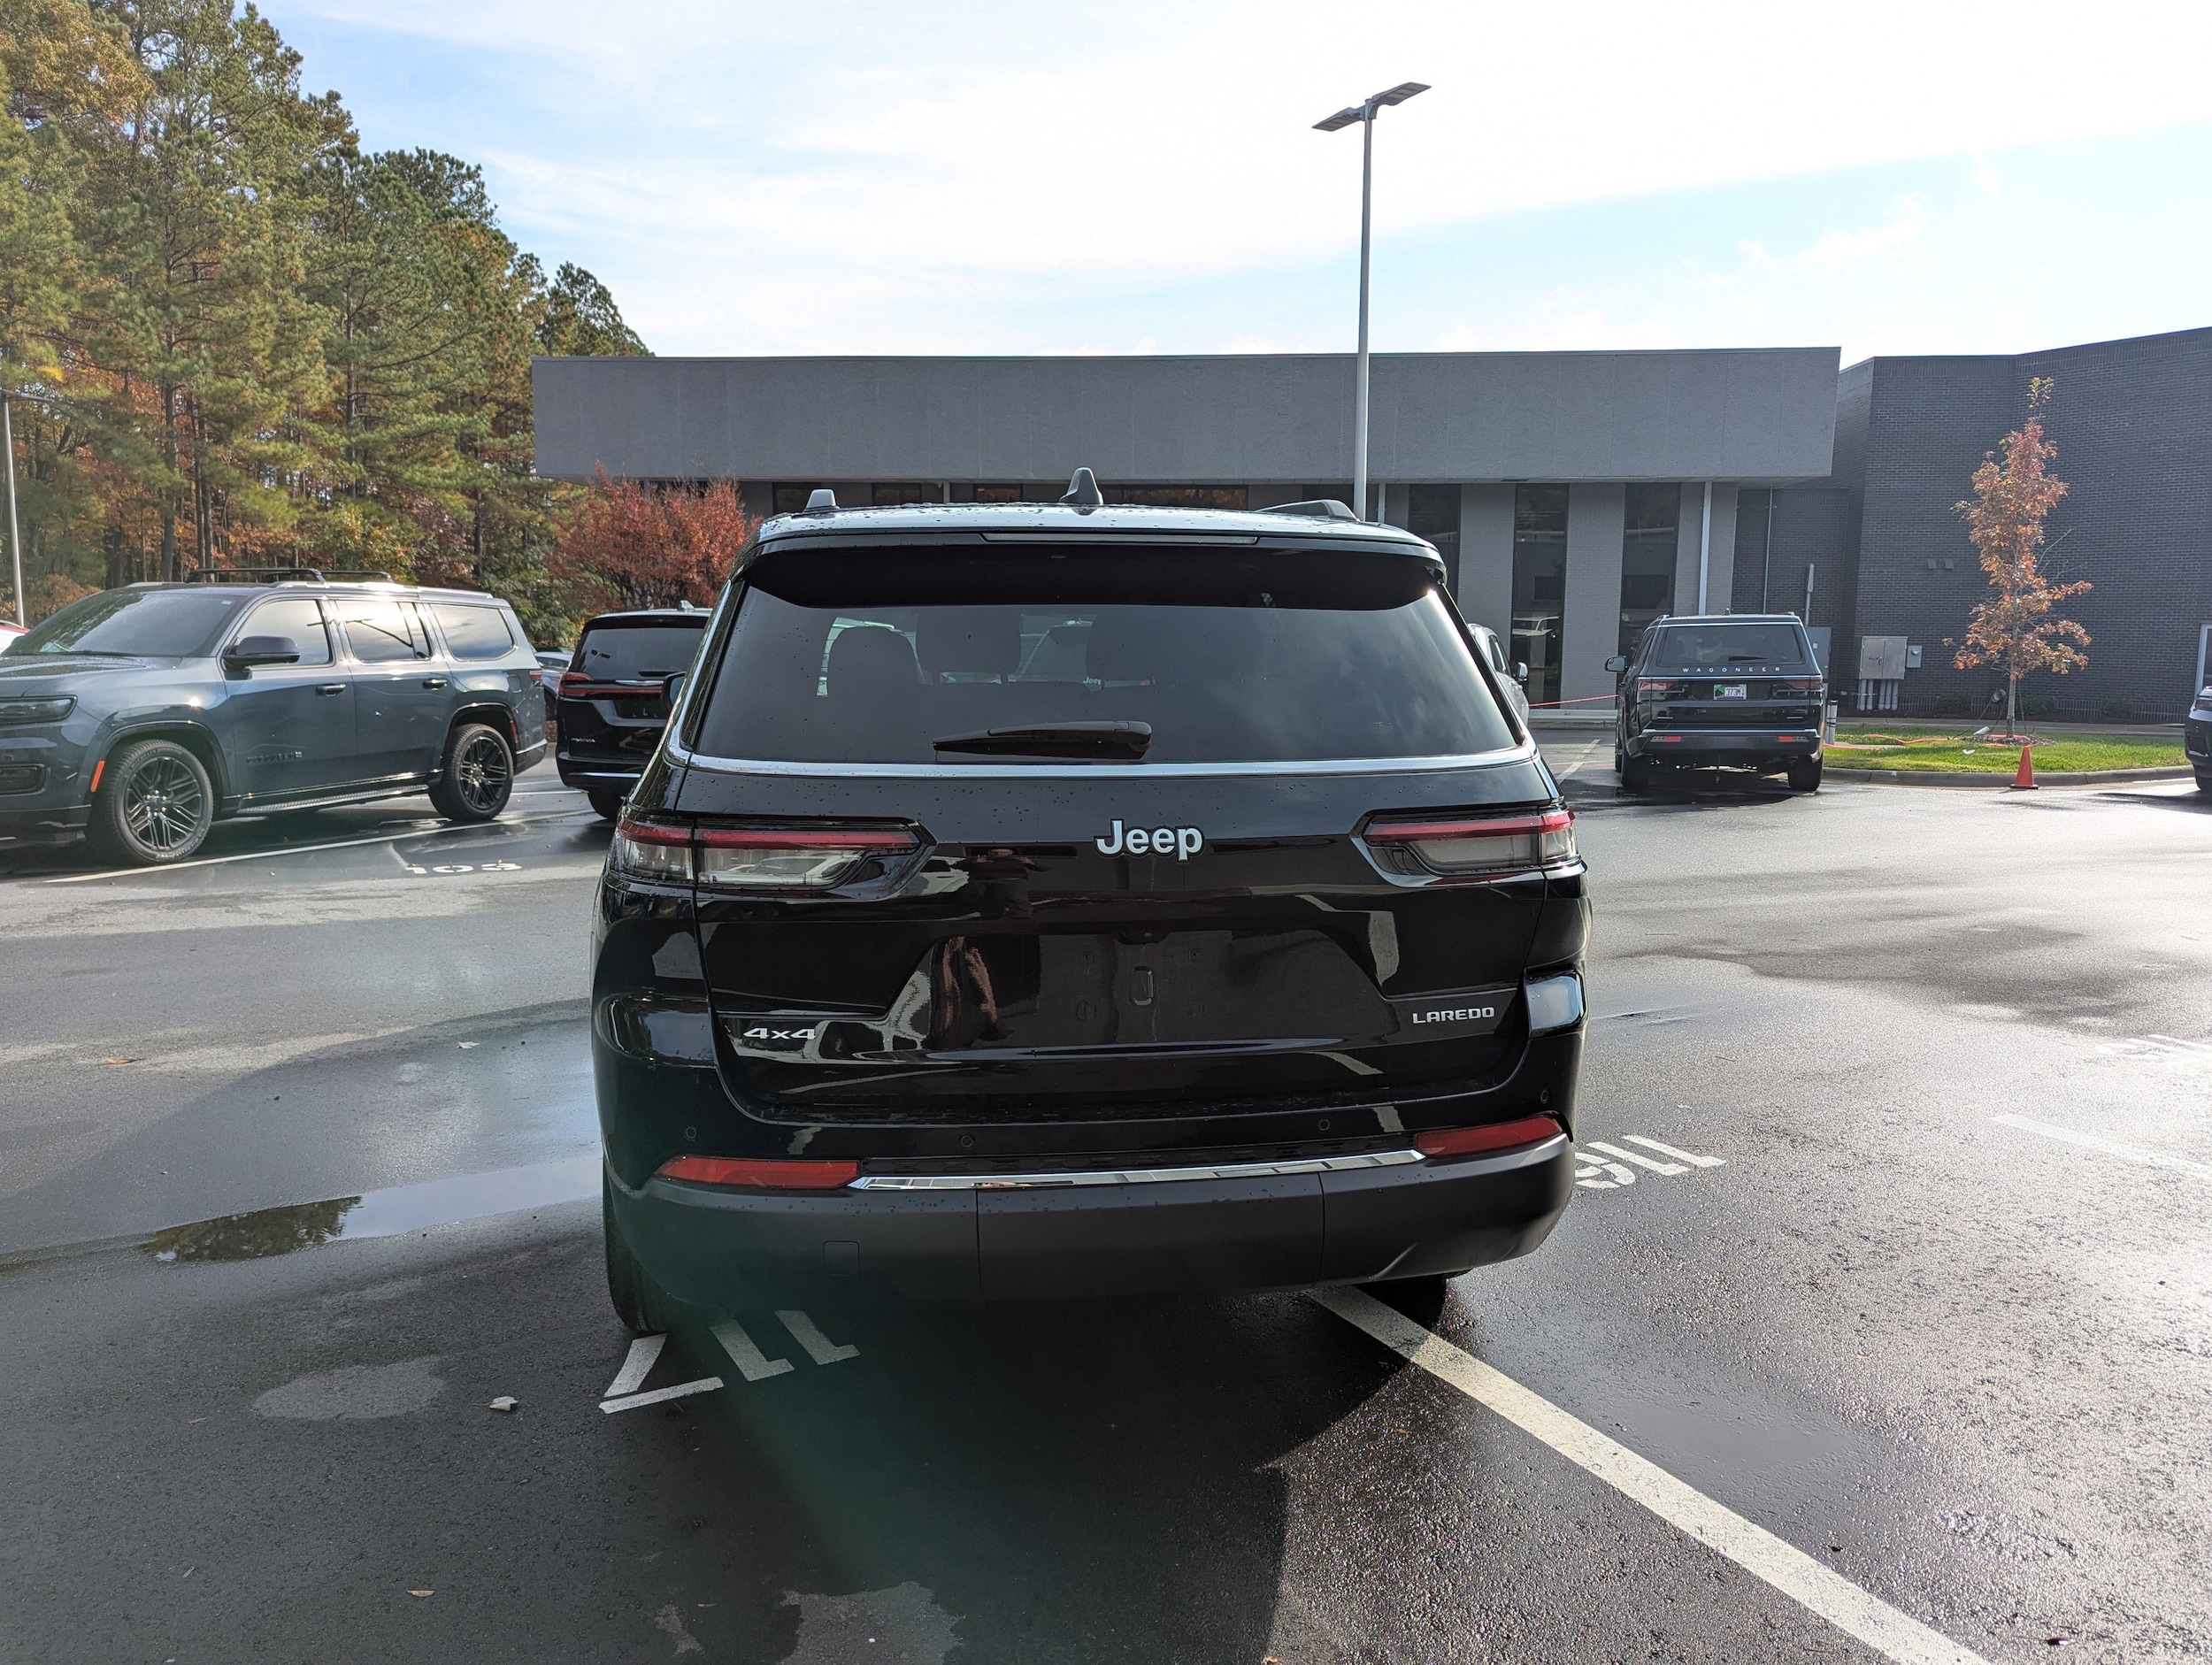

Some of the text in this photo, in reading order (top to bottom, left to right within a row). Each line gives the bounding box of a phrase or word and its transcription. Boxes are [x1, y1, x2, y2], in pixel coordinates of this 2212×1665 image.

[1095, 819, 1204, 862] Jeep
[1412, 1007, 1495, 1024] LAREDO
[743, 1027, 817, 1040] 4x4
[598, 1309, 861, 1415] 117
